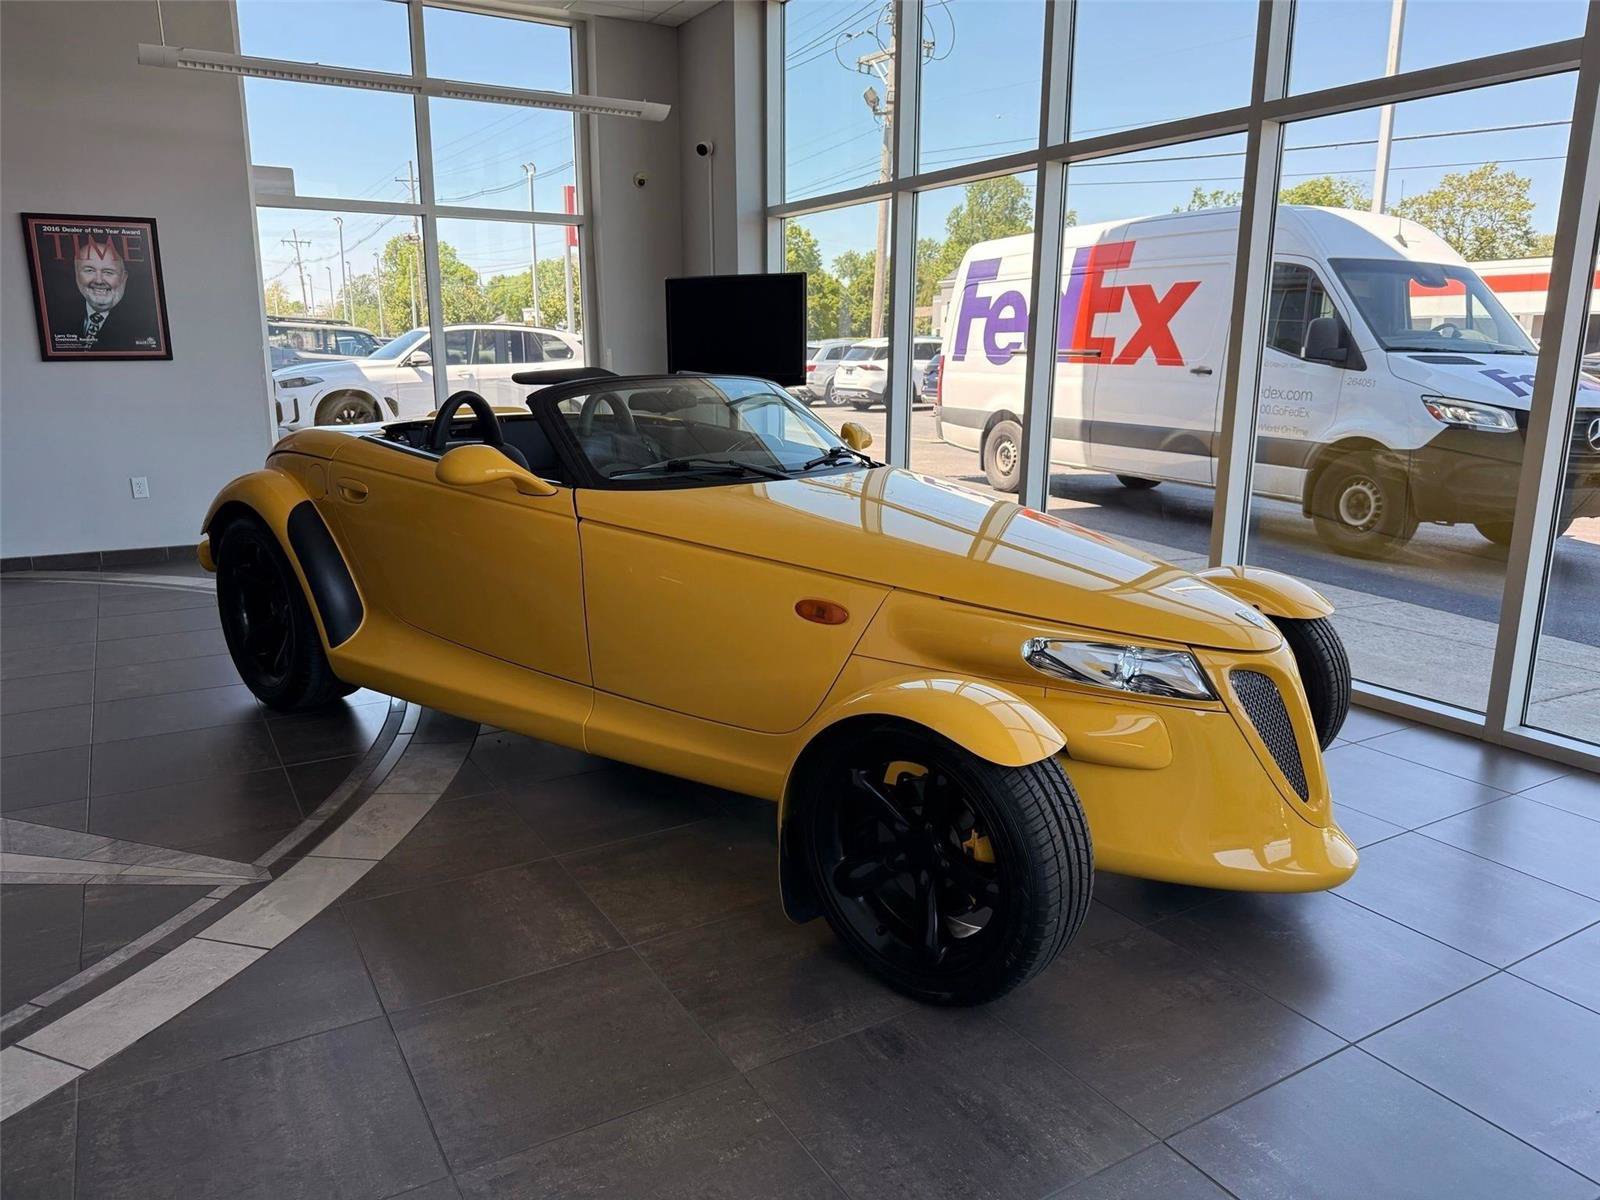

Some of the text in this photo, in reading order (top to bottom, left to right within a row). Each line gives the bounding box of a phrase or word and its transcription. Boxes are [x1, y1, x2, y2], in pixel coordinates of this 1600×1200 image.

[43, 232, 144, 262] TIME
[952, 241, 1201, 367] FedEx
[1261, 386, 1313, 401] dex.com
